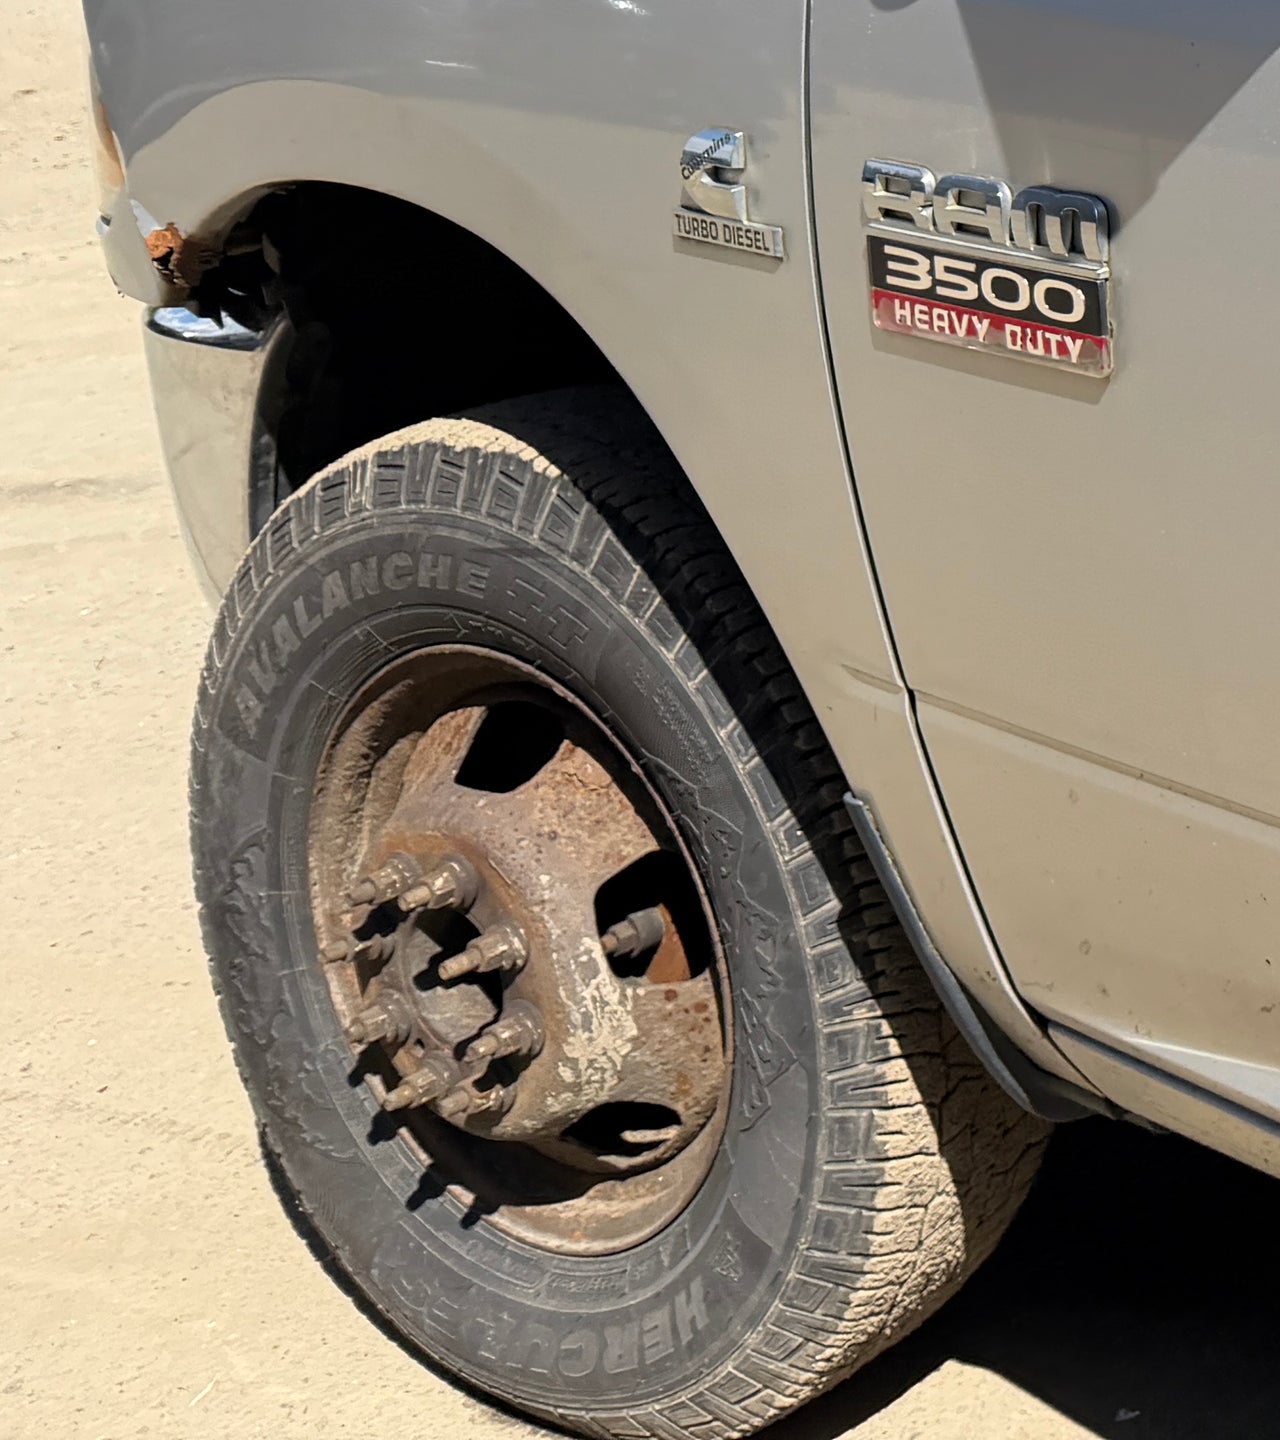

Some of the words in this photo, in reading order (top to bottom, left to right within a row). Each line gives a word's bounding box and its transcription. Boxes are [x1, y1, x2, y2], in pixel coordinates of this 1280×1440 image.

[675, 213, 719, 241] TURBO
[722, 223, 770, 252] DIESEL
[862, 157, 1110, 262] RAM
[883, 244, 1086, 324] 3500
[894, 297, 991, 343] HEAVY
[1004, 322, 1084, 364] DUTY
[235, 551, 492, 741] AVALANCHE
